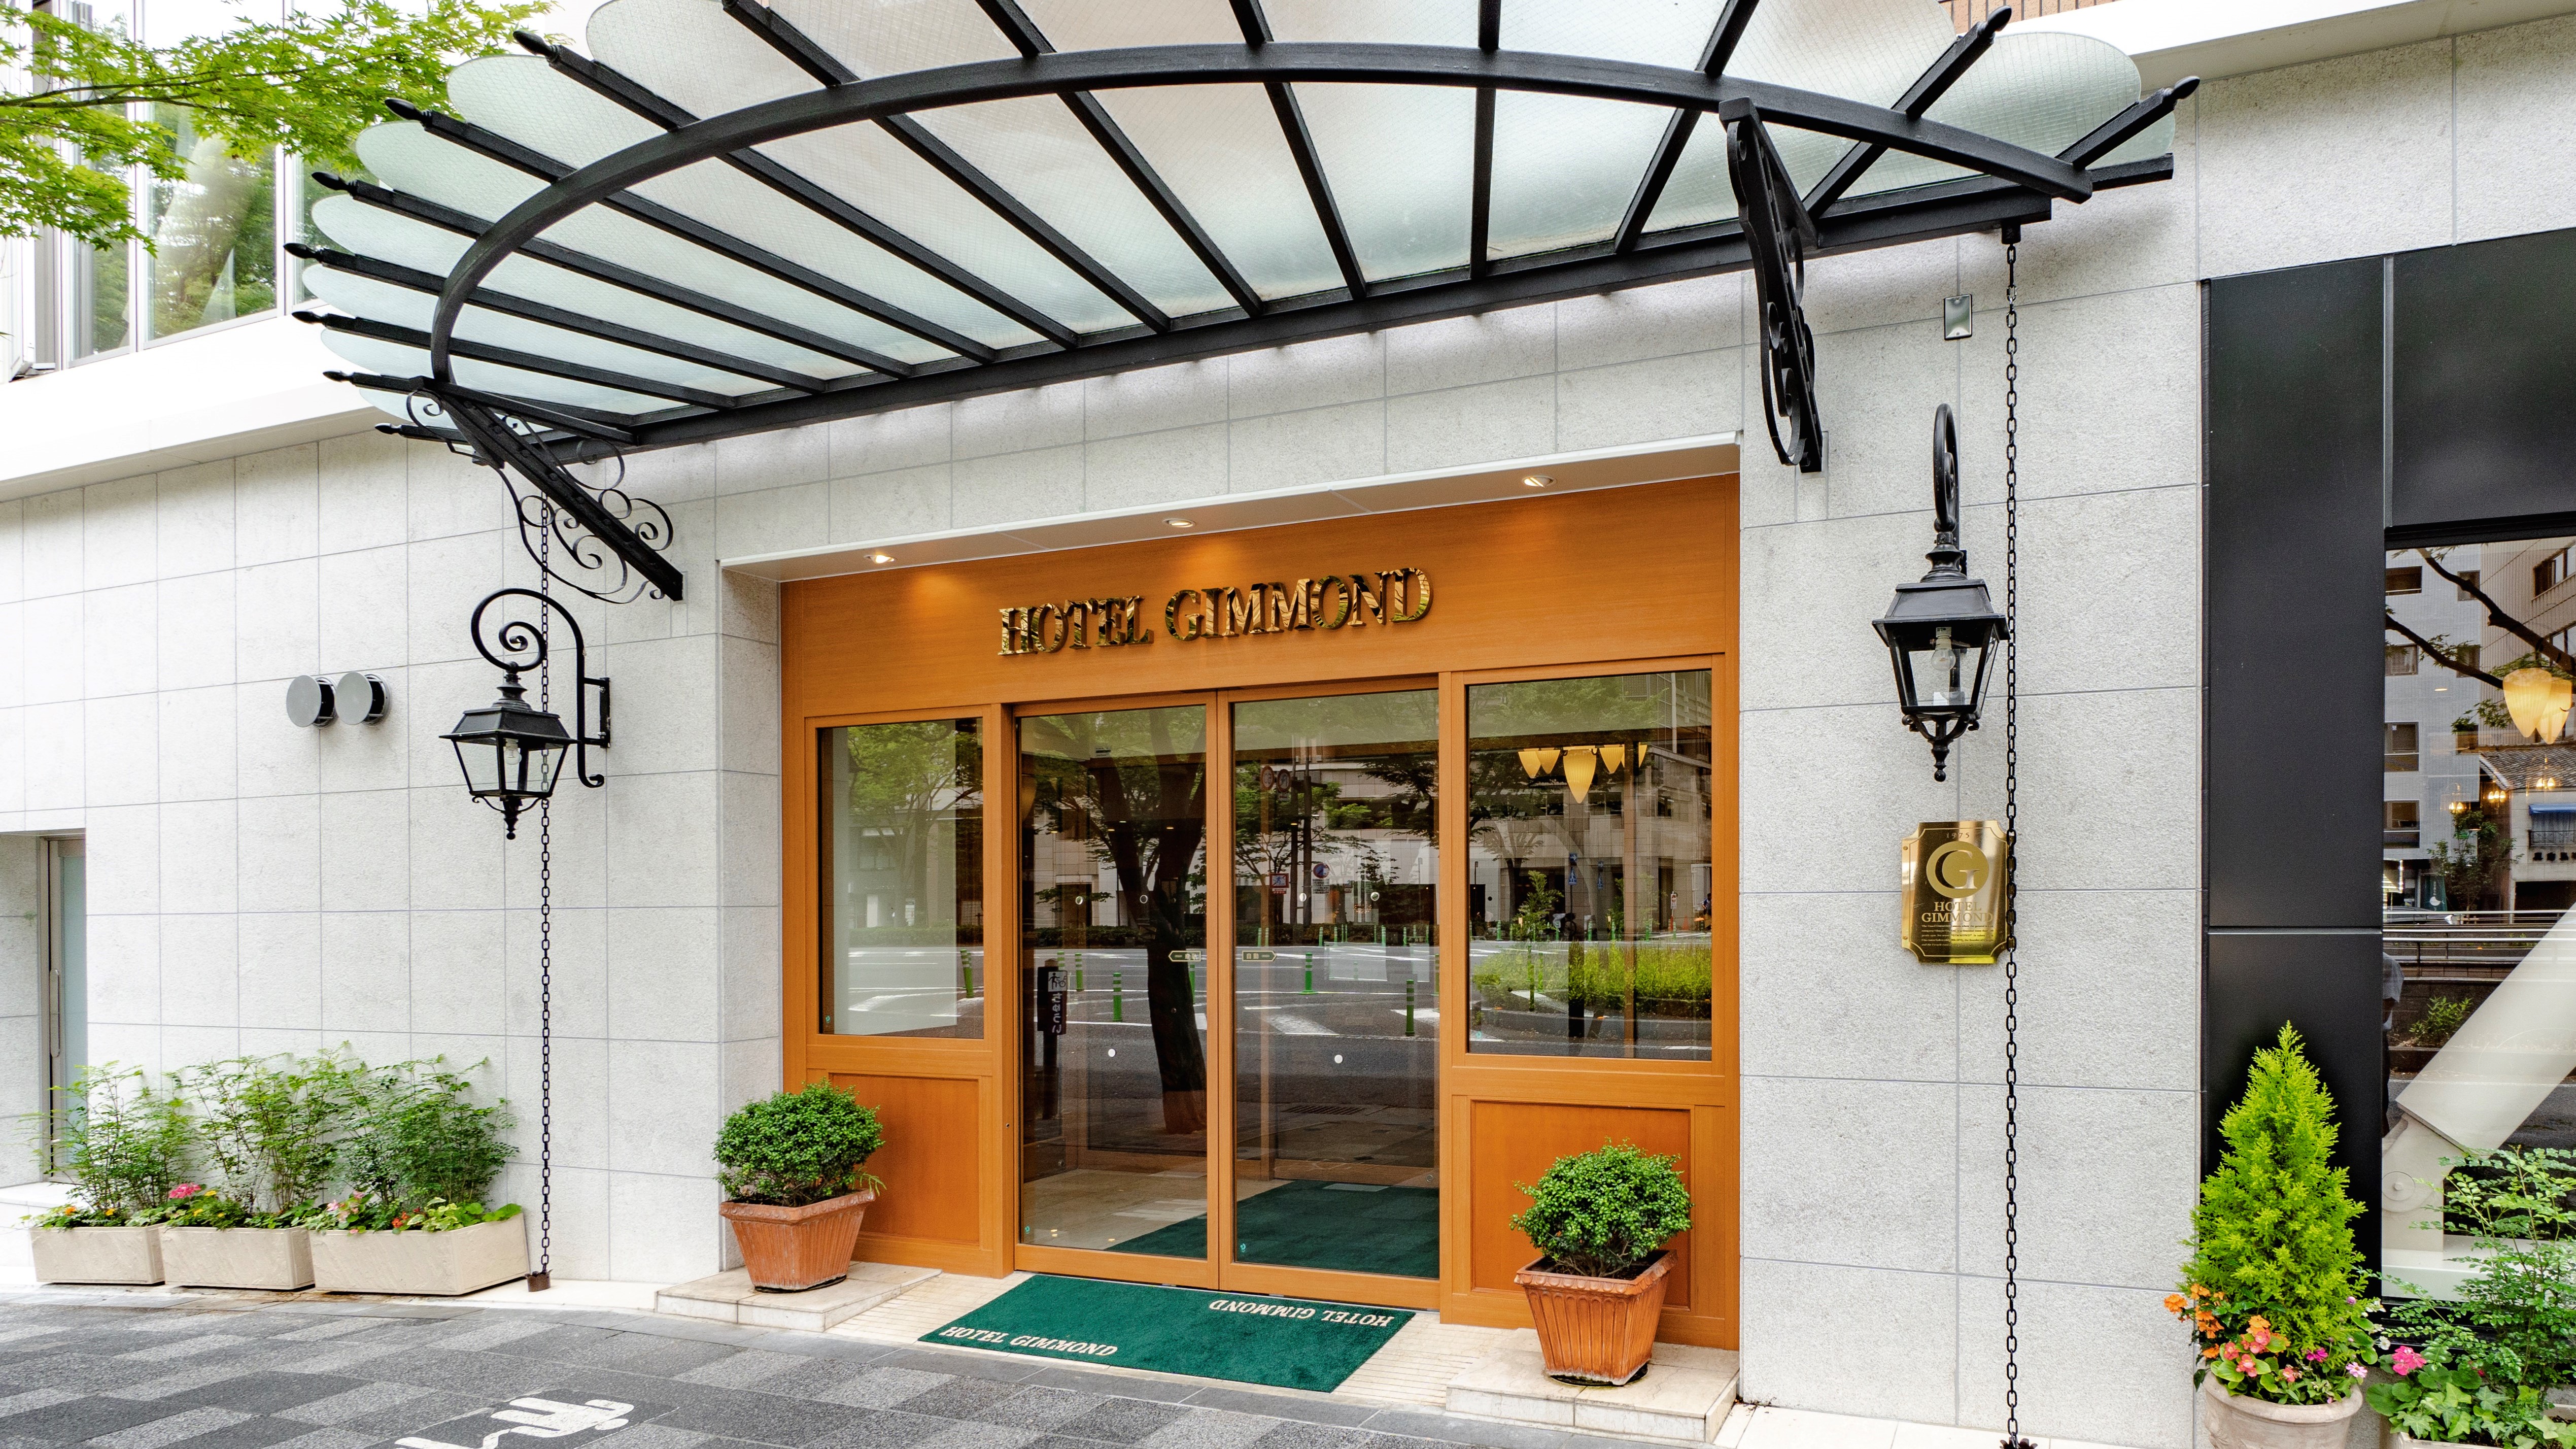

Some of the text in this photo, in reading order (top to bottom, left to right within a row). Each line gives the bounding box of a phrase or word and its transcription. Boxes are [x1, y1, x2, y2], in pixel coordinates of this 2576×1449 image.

[998, 567, 1434, 656] HOTEL GIMMOND
[1935, 850, 1980, 890] G
[1921, 913, 1994, 923] GIMMOND
[1934, 901, 1981, 912] HOTEL
[1209, 1299, 1395, 1327] HOTEL GIMMOND
[939, 1326, 1118, 1356] HOTEL GIMMOND
